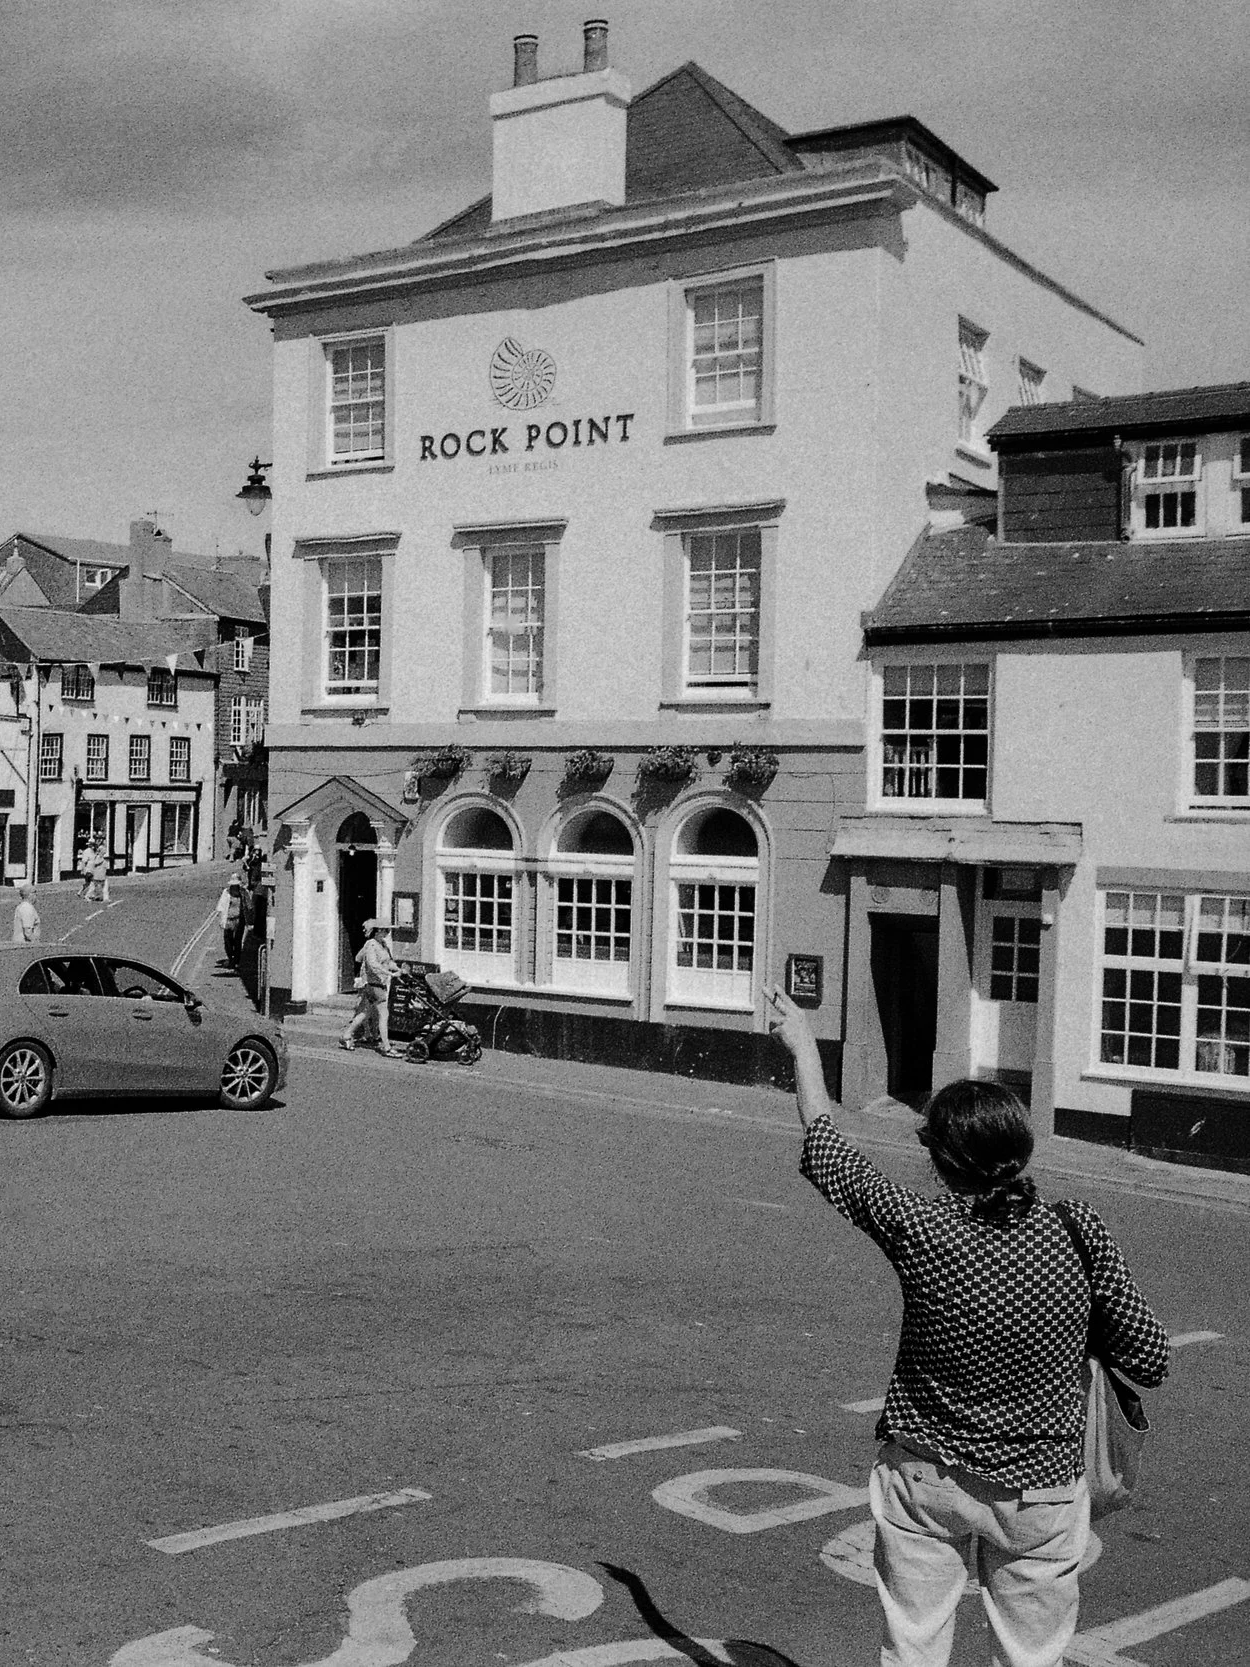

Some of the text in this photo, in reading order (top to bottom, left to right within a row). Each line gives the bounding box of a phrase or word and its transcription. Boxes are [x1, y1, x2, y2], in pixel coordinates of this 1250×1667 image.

[419, 413, 635, 461] ROCK POINT
[524, 460, 559, 473] REGIS
